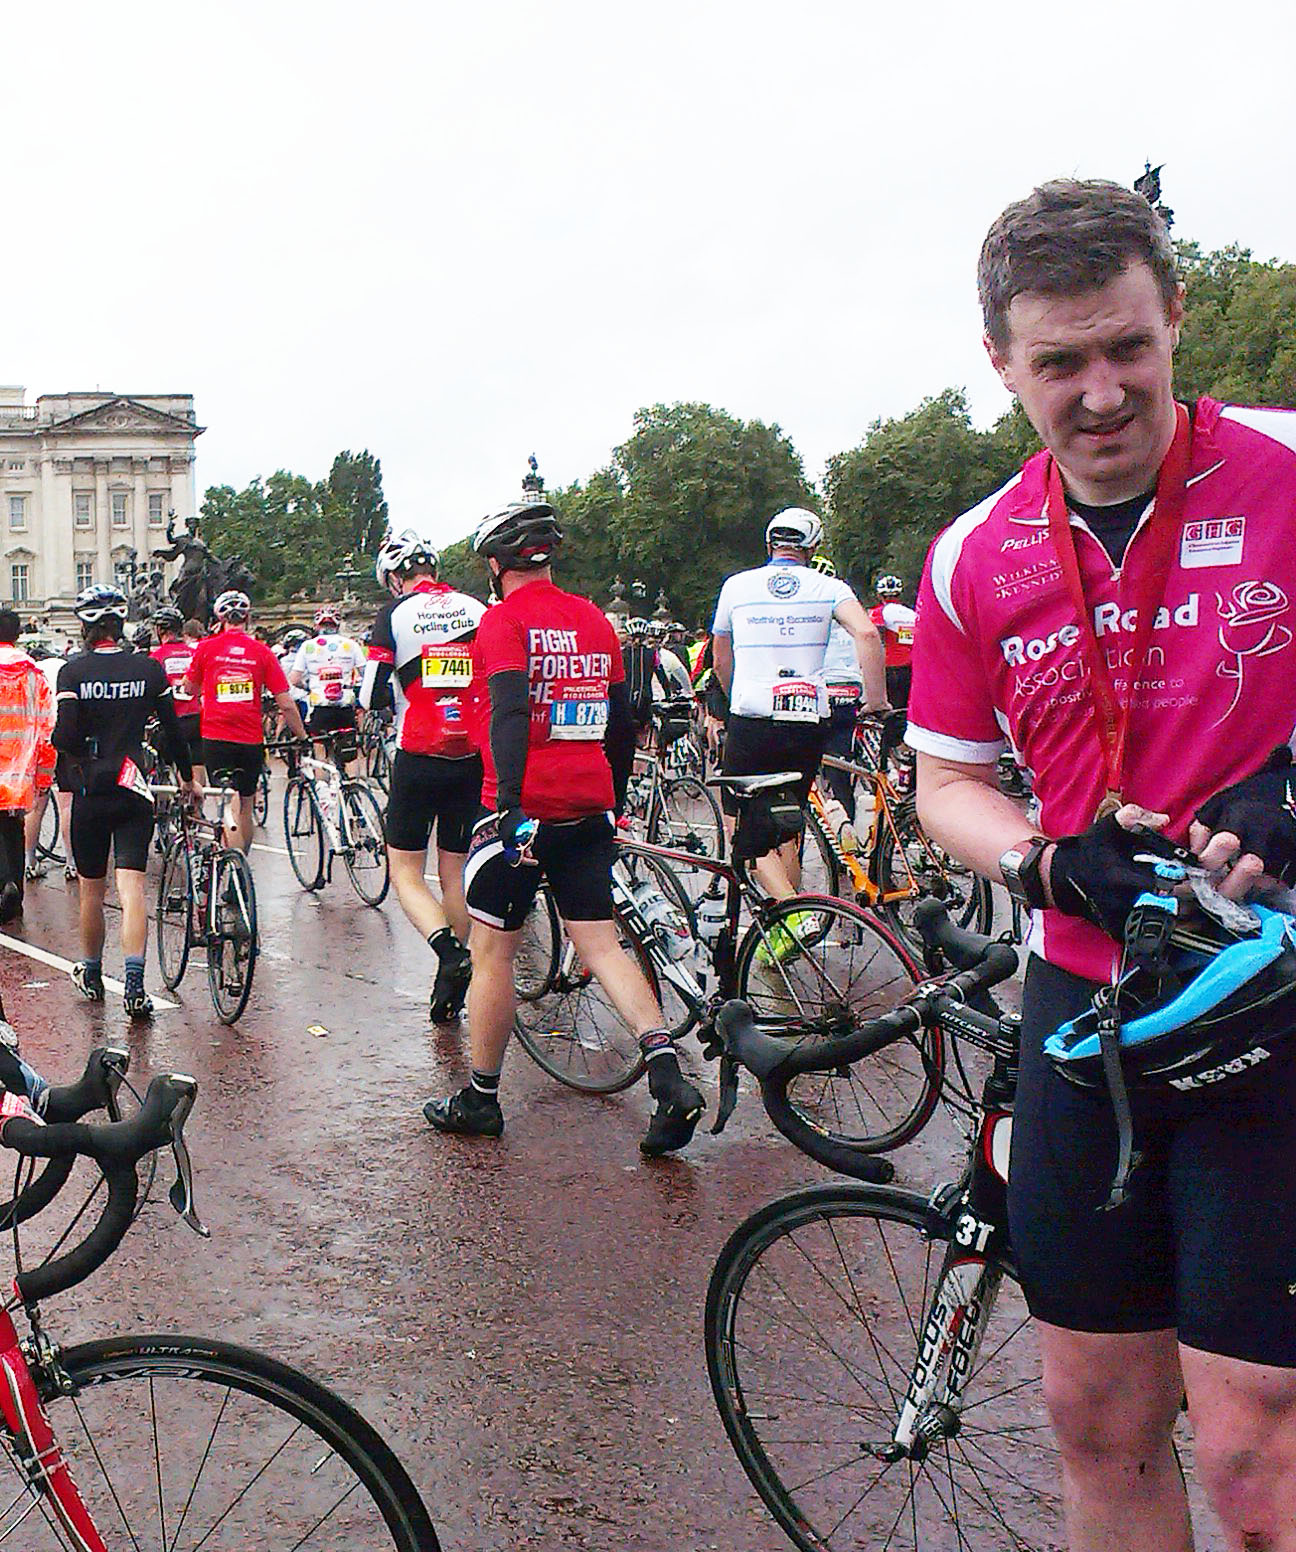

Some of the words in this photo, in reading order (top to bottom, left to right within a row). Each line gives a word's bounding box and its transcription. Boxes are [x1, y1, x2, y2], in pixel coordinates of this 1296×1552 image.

[1185, 520, 1242, 541] GHG
[413, 621, 449, 634] Cycling
[450, 617, 475, 630] Club
[417, 607, 466, 620] Horwood
[528, 628, 579, 653] FIGHT
[1000, 623, 1081, 667] Rose
[425, 660, 432, 676] F
[440, 659, 470, 676] 7441
[1010, 645, 1165, 702] Assocition
[80, 680, 146, 700] MOLTENI
[556, 703, 565, 725] H
[576, 702, 608, 725] 8739
[955, 1214, 995, 1252] 3T
[906, 1302, 948, 1408] FOCUS
[946, 1301, 981, 1399] FOCU
